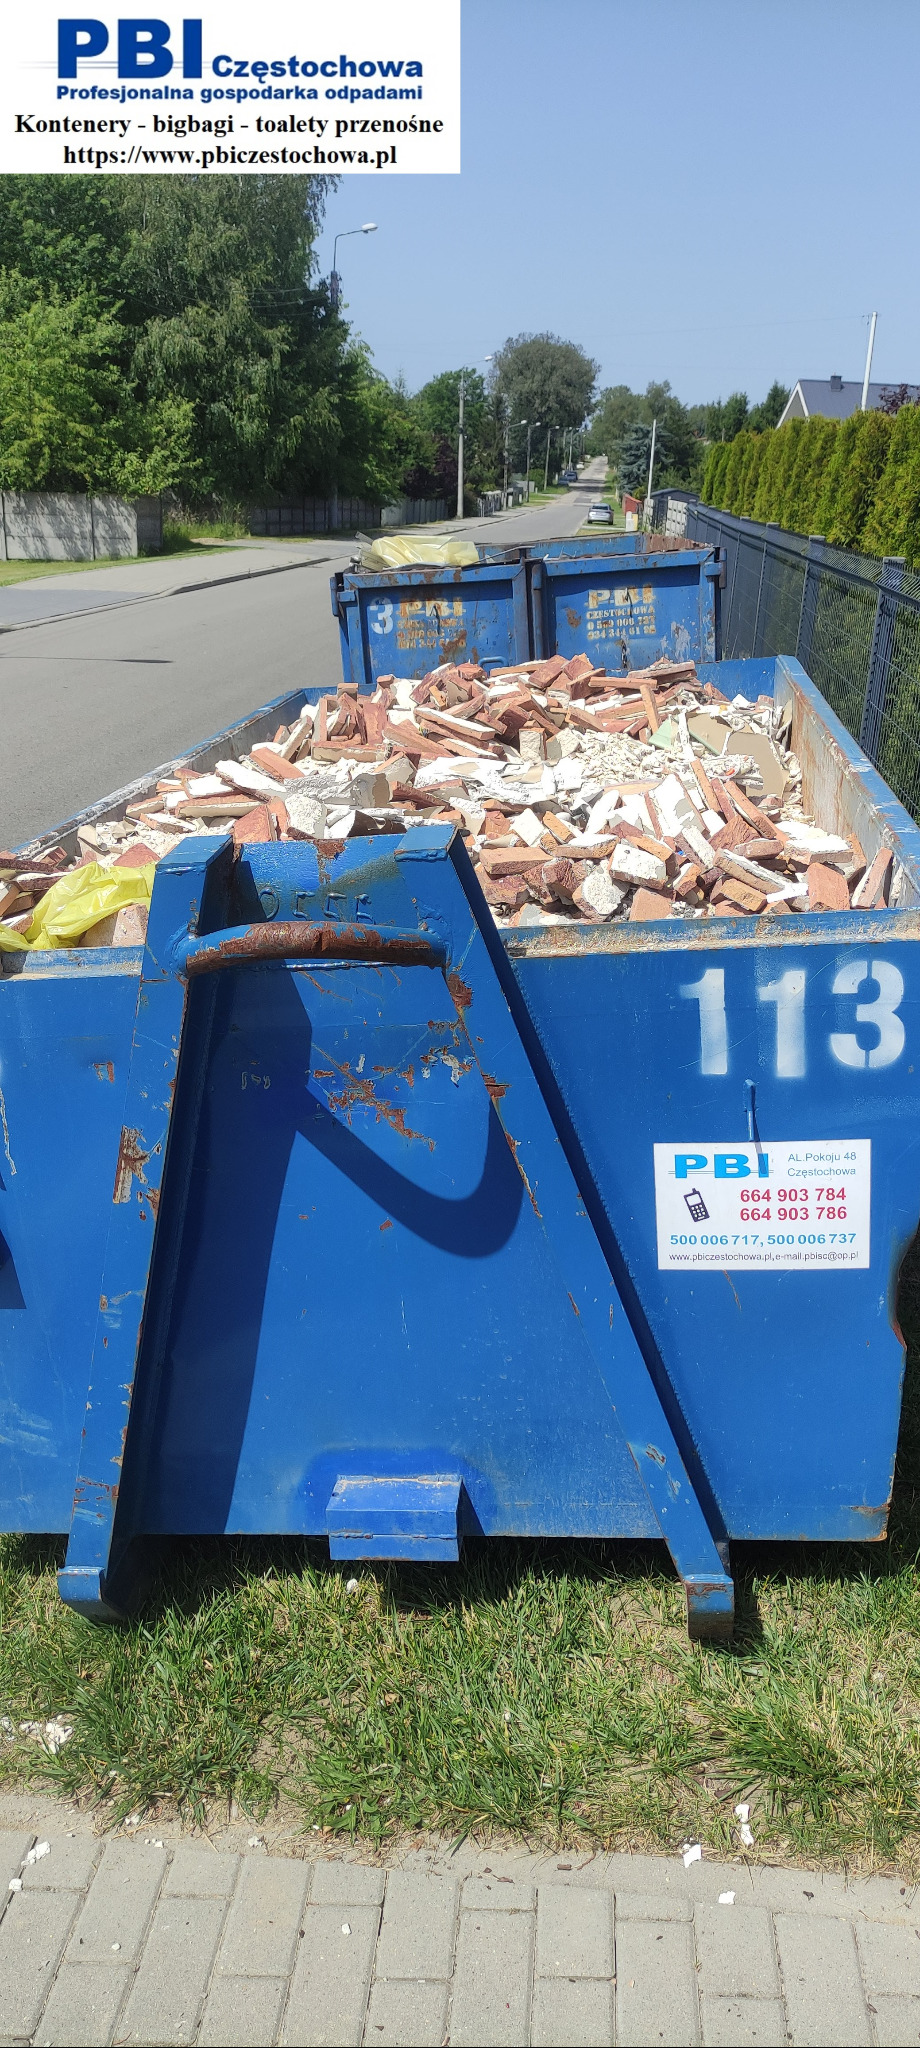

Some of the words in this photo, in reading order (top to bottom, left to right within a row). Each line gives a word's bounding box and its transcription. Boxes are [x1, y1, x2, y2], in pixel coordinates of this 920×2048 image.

[370, 598, 394, 634] 3
[680, 960, 905, 1077] 113
[674, 1153, 770, 1179] PBI
[843, 1152, 857, 1161] 48
[787, 1167, 856, 1178] Częstochowa
[740, 1189, 772, 1203] 664
[777, 1188, 809, 1201] 903
[815, 1187, 847, 1201] 784
[740, 1208, 772, 1221] 664
[777, 1208, 810, 1220] 903
[815, 1206, 848, 1220] 786
[670, 1235, 697, 1245] 500
[700, 1235, 729, 1245] 006
[731, 1235, 764, 1247] 717,
[767, 1234, 795, 1244] 500
[798, 1234, 826, 1244] 006
[829, 1233, 857, 1244] 737
